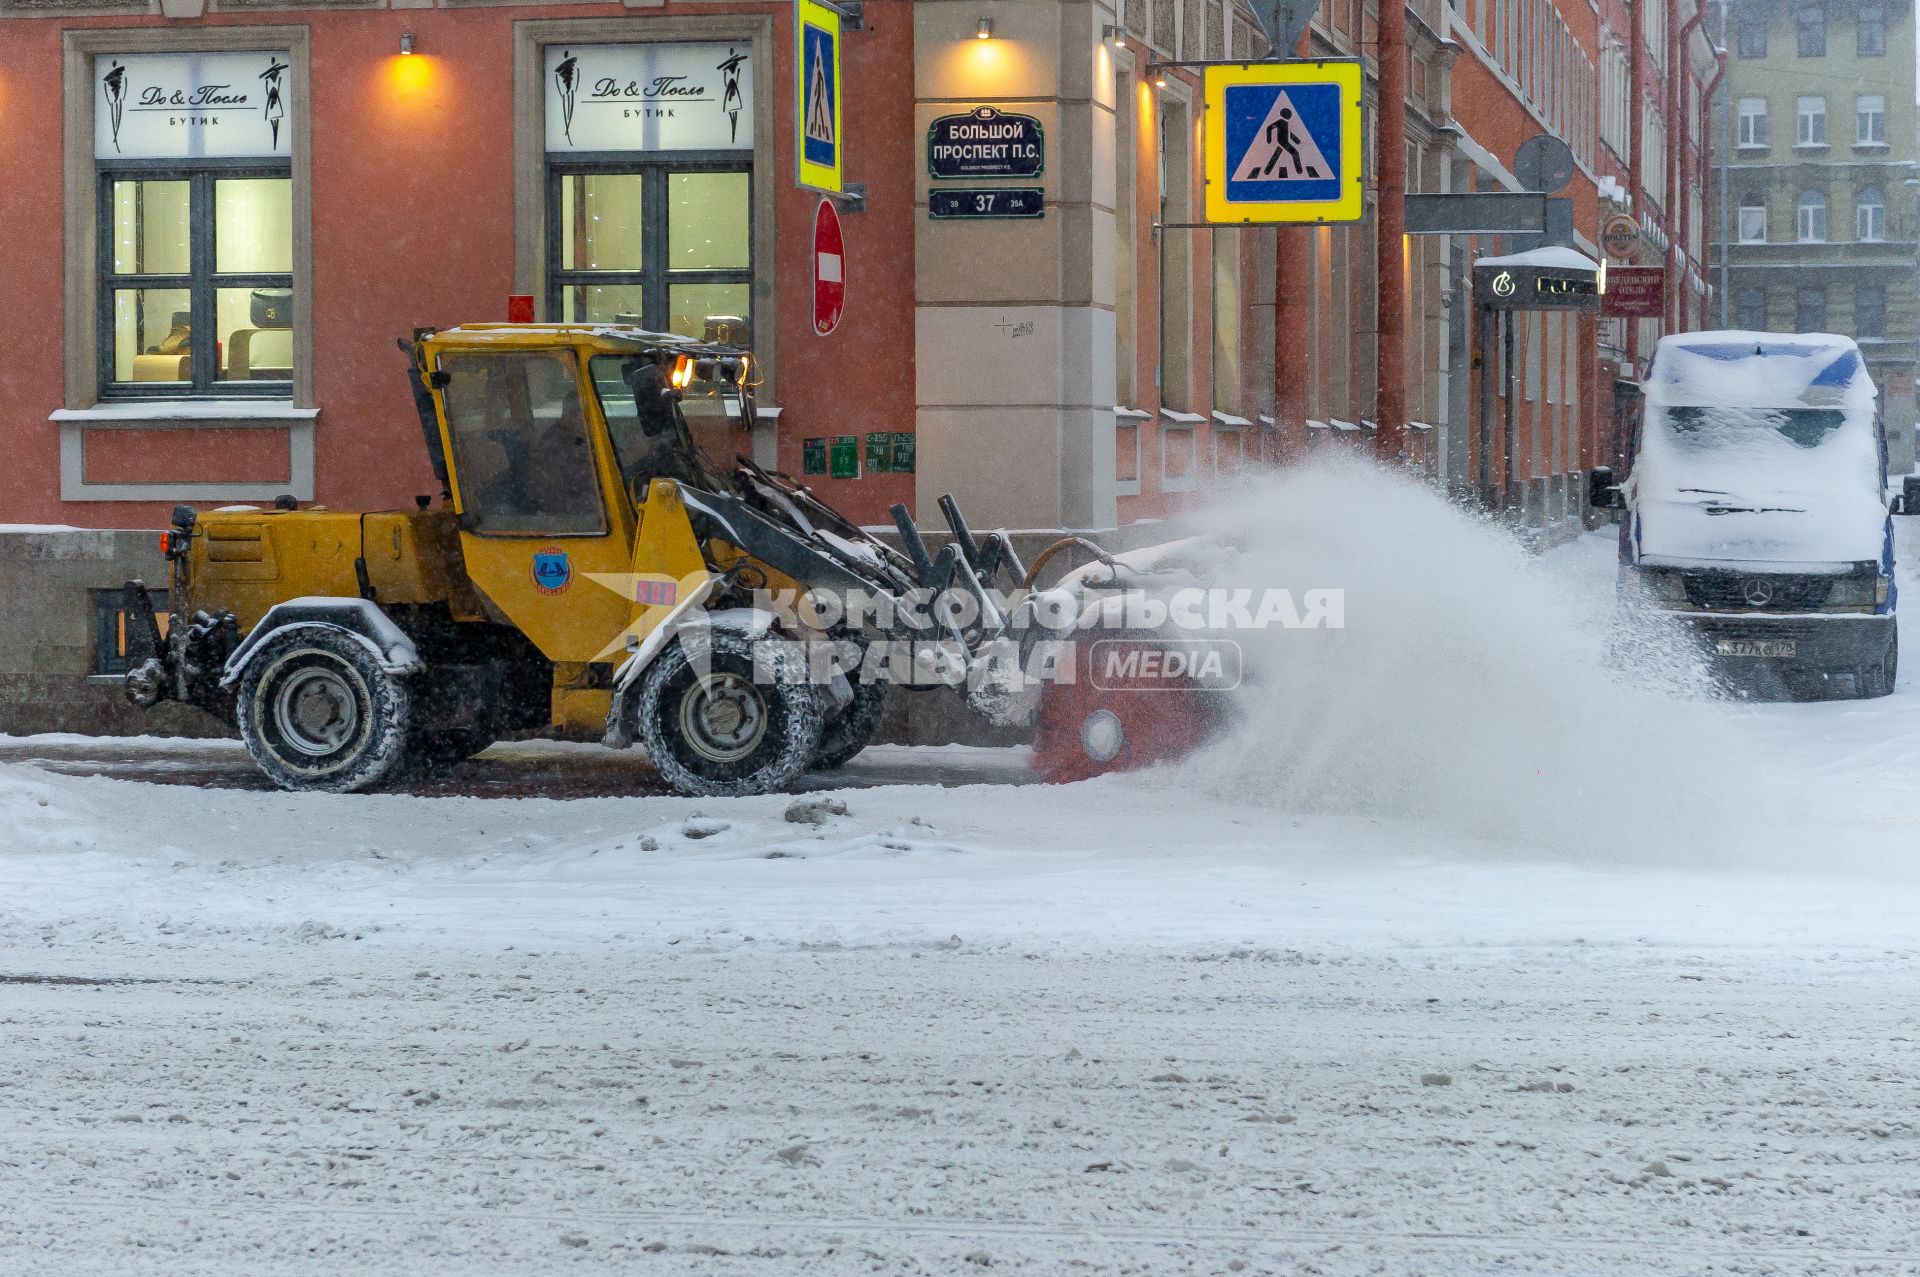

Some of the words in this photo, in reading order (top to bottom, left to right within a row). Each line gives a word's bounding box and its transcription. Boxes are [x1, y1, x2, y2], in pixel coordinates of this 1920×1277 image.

[139, 86, 168, 105] До
[170, 89, 186, 105] &
[188, 84, 248, 105] После
[592, 77, 621, 97] До
[624, 81, 640, 96] &
[643, 75, 705, 97] После
[169, 117, 219, 126] БУТИК
[623, 108, 675, 118] БУТИК
[949, 121, 1023, 140] БОЛЬШОЙ
[933, 144, 1009, 160] ПРОСПЕКТ
[1012, 143, 1040, 158] П.С.
[950, 200, 959, 208] 39
[975, 194, 995, 212] 37
